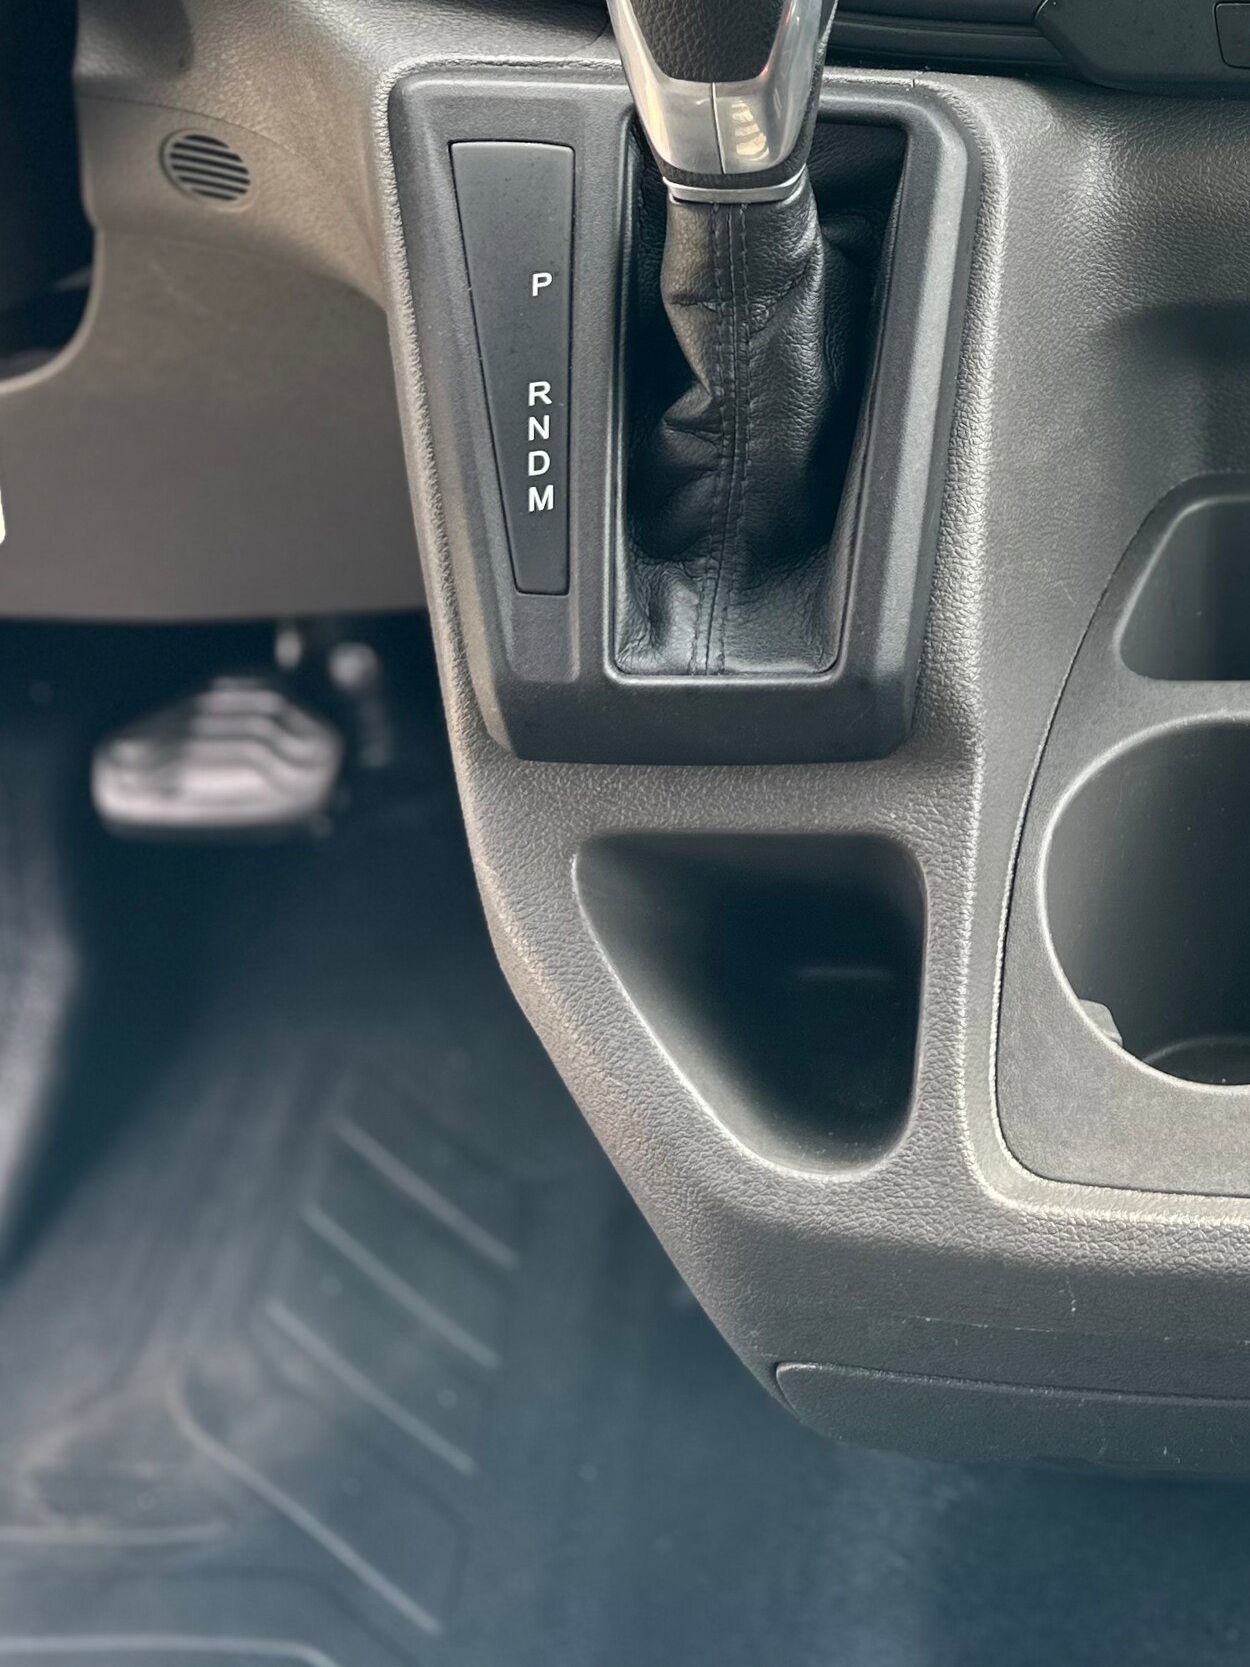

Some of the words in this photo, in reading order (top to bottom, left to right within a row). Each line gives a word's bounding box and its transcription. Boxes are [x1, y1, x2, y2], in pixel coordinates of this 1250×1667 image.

[532, 272, 553, 297] P
[528, 380, 553, 407] R
[528, 414, 550, 441] N
[528, 450, 551, 477] D
[528, 484, 554, 512] M
